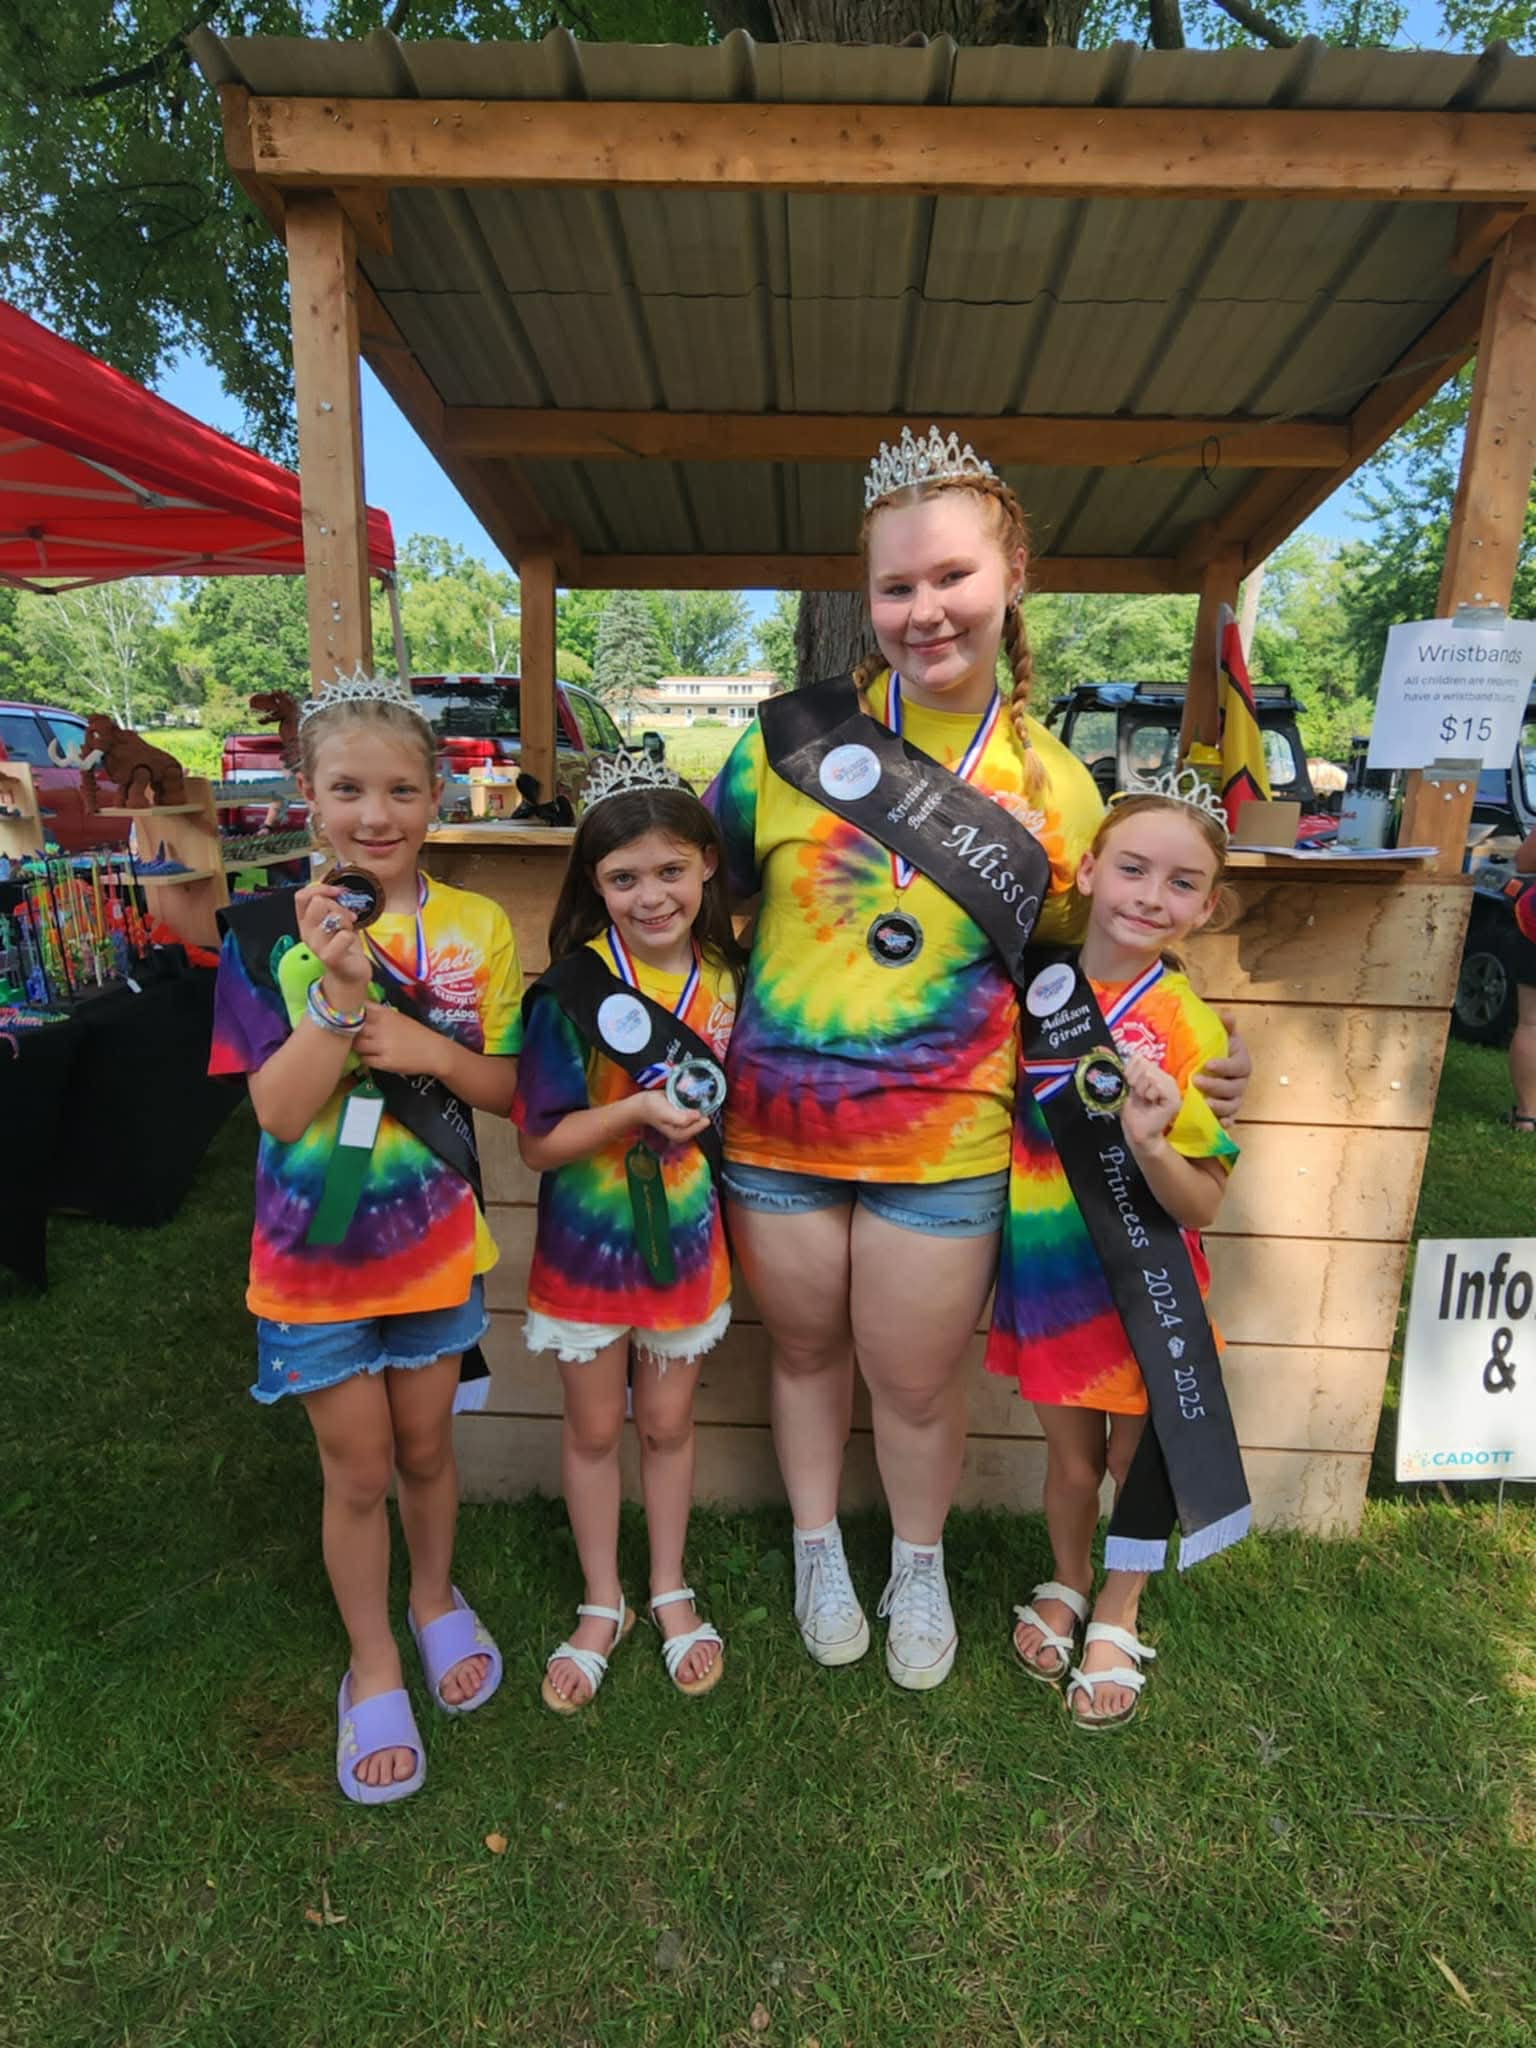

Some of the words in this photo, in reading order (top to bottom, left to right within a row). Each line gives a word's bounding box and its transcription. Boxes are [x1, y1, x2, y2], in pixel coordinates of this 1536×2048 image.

[1418, 645, 1523, 665] Wristbands
[1403, 676, 1419, 686] All
[1421, 676, 1467, 686] children
[1469, 677, 1484, 686] are
[1403, 692, 1431, 701] have
[1443, 692, 1493, 701] wristband
[1439, 714, 1493, 744] $15
[887, 779, 929, 823] Kristina
[941, 824, 1024, 903] Miss
[1040, 1004, 1091, 1034] Addison
[1048, 1016, 1092, 1049] Girard
[1099, 1144, 1150, 1249] Princess
[1142, 1267, 1184, 1329] 2024
[1174, 1365, 1206, 1421] 2025
[1482, 1327, 1517, 1394] &
[1431, 1450, 1515, 1466] CADOTT
